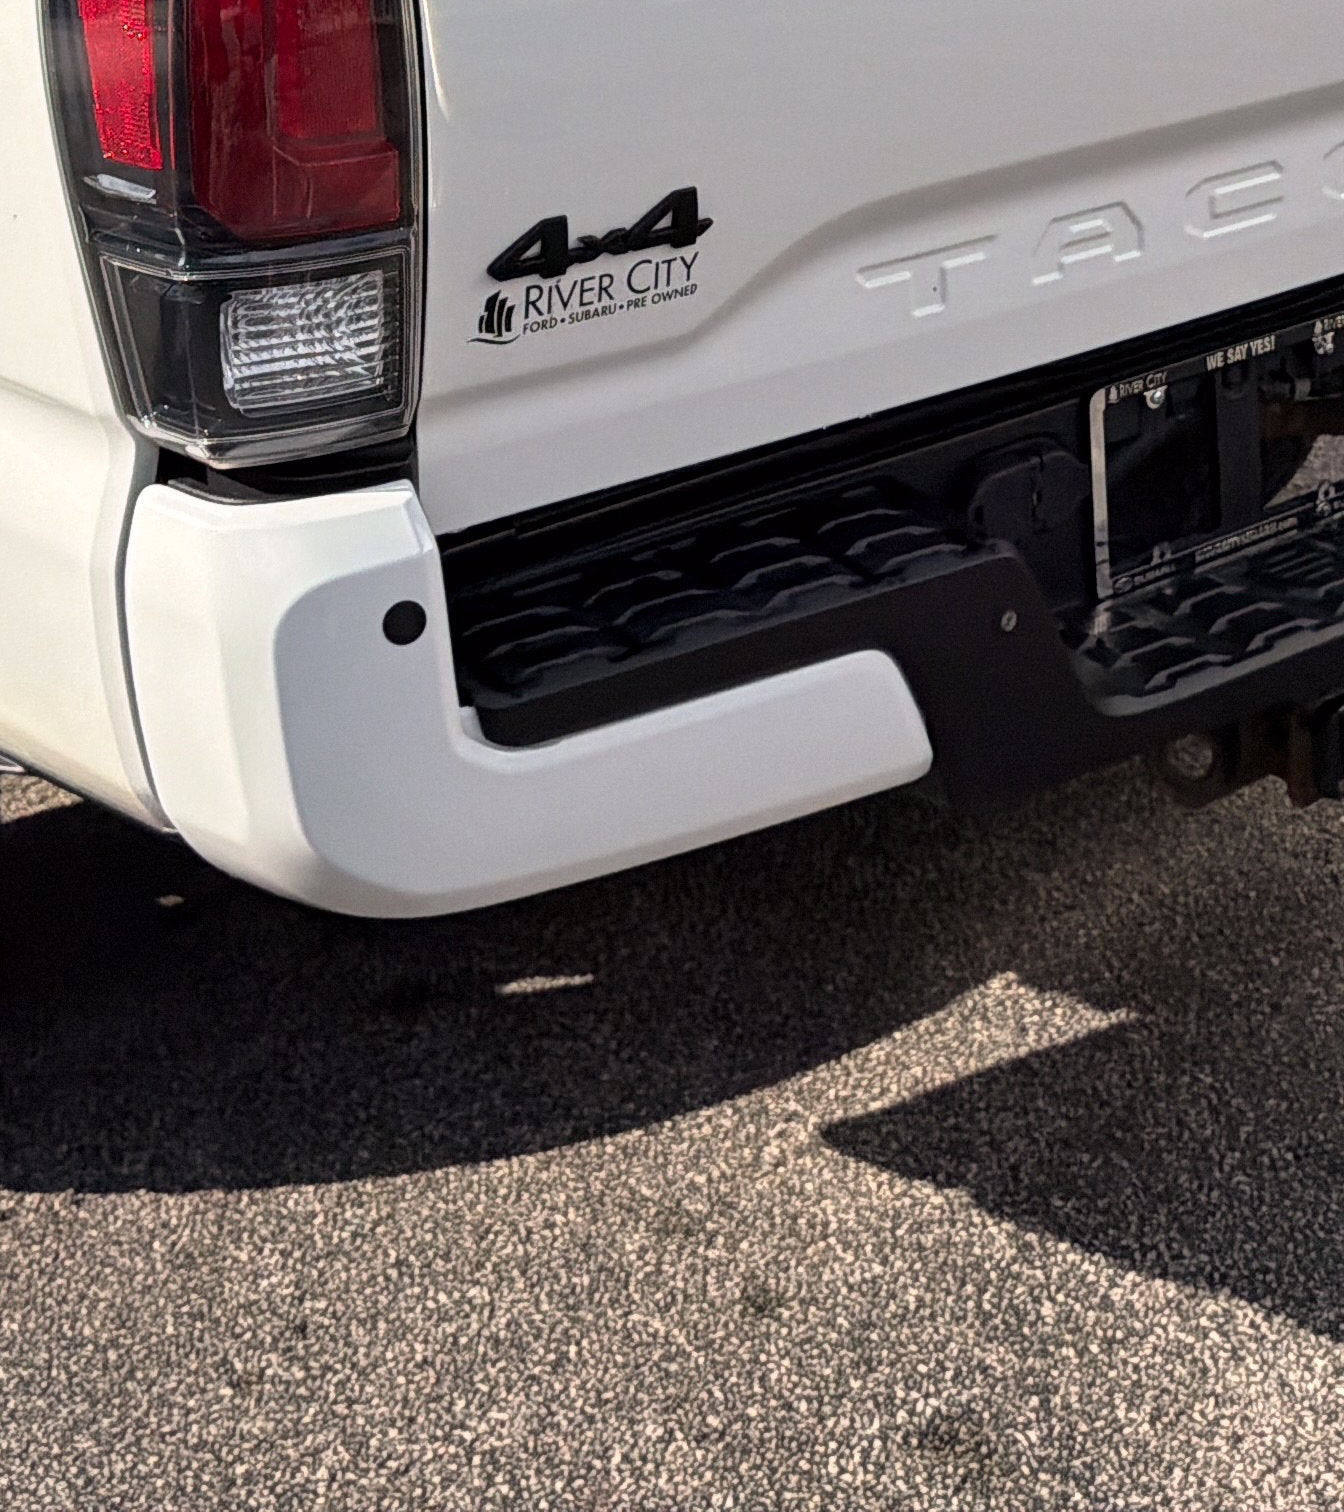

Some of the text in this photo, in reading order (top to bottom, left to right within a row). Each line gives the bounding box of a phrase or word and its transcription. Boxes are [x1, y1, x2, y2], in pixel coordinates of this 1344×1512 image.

[523, 251, 700, 319] RIVER CITY
[523, 283, 698, 336] FORD SUBARU PRE OWNED
[1206, 335, 1276, 371] WE SAY YES!
[1119, 371, 1168, 398] RIVER CITY
